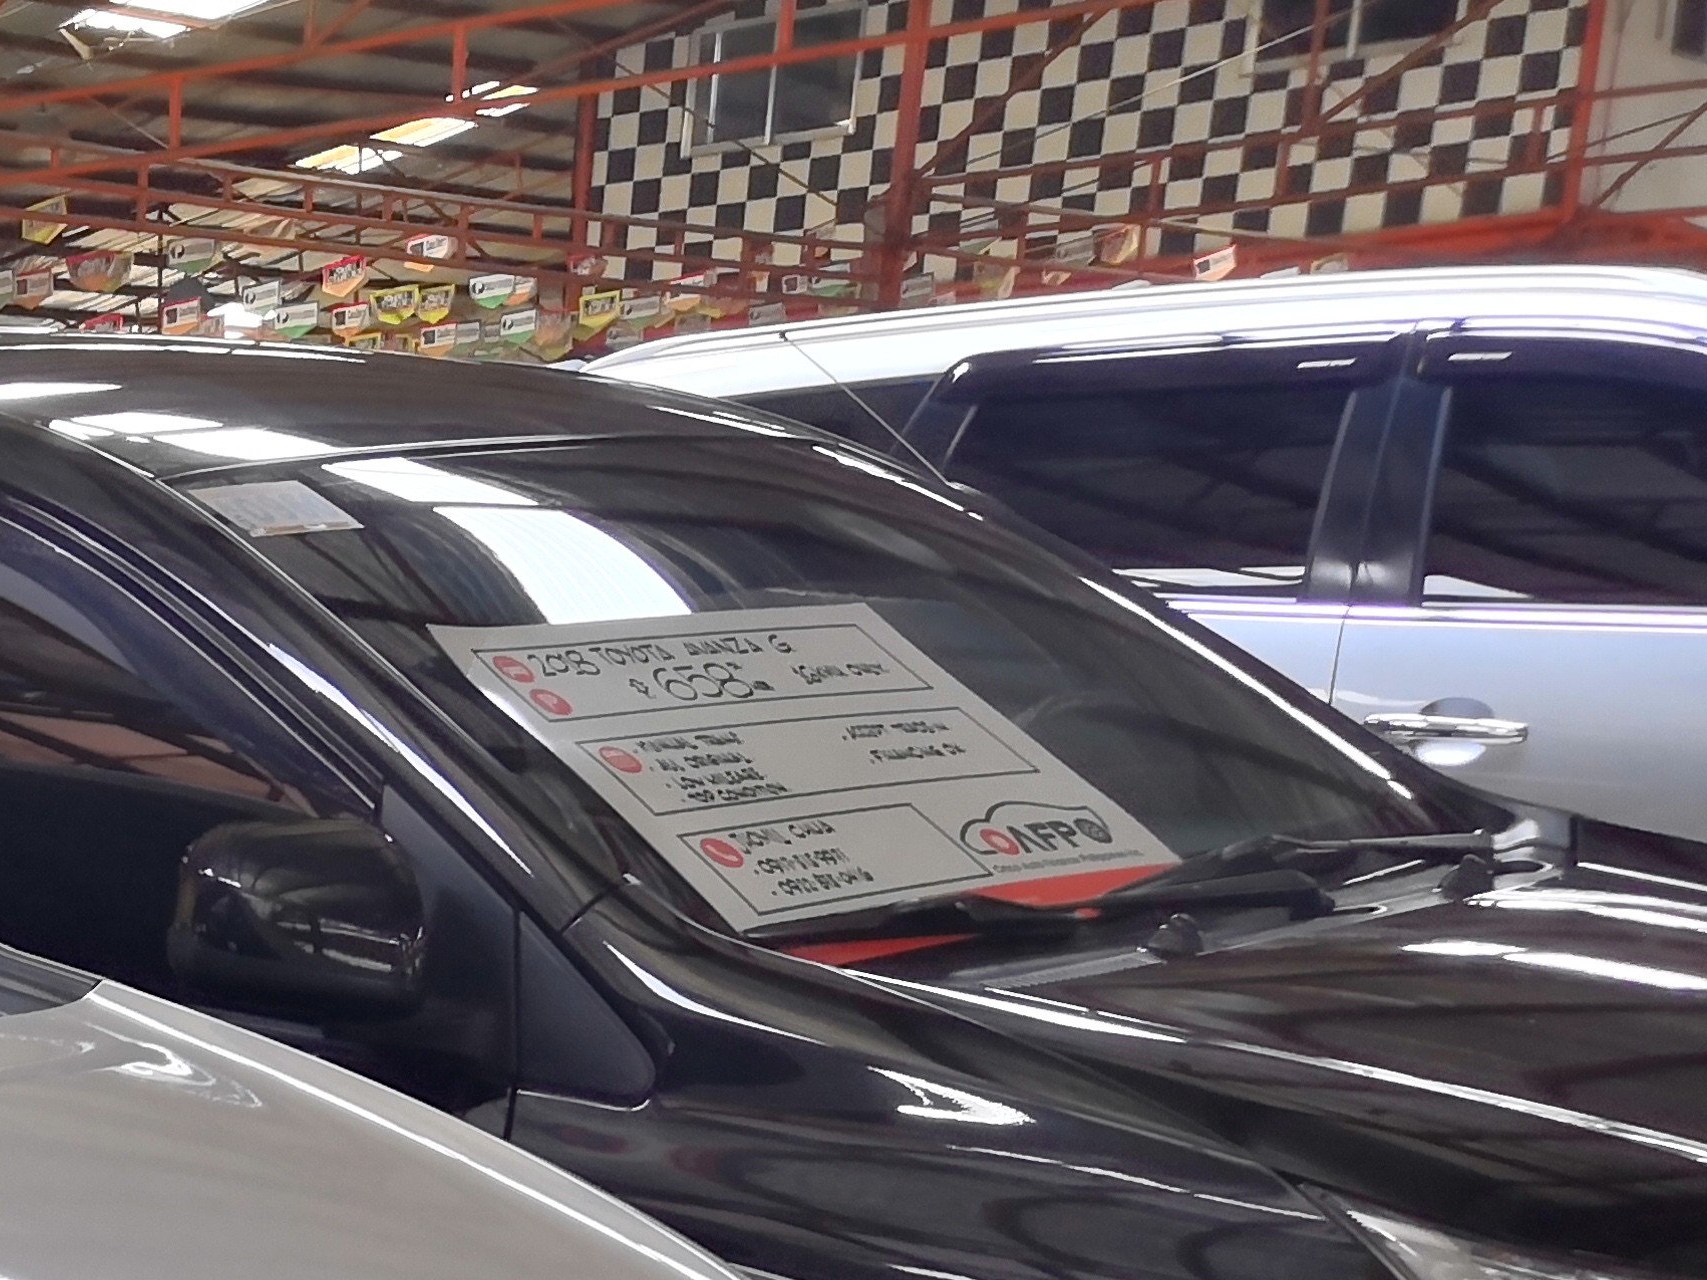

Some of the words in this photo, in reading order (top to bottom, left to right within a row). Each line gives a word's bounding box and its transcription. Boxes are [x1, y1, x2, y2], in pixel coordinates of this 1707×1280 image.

[527, 650, 600, 677] 2018
[588, 644, 675, 665] TOYOTA
[683, 637, 764, 656] AVANZA
[768, 633, 794, 654] G
